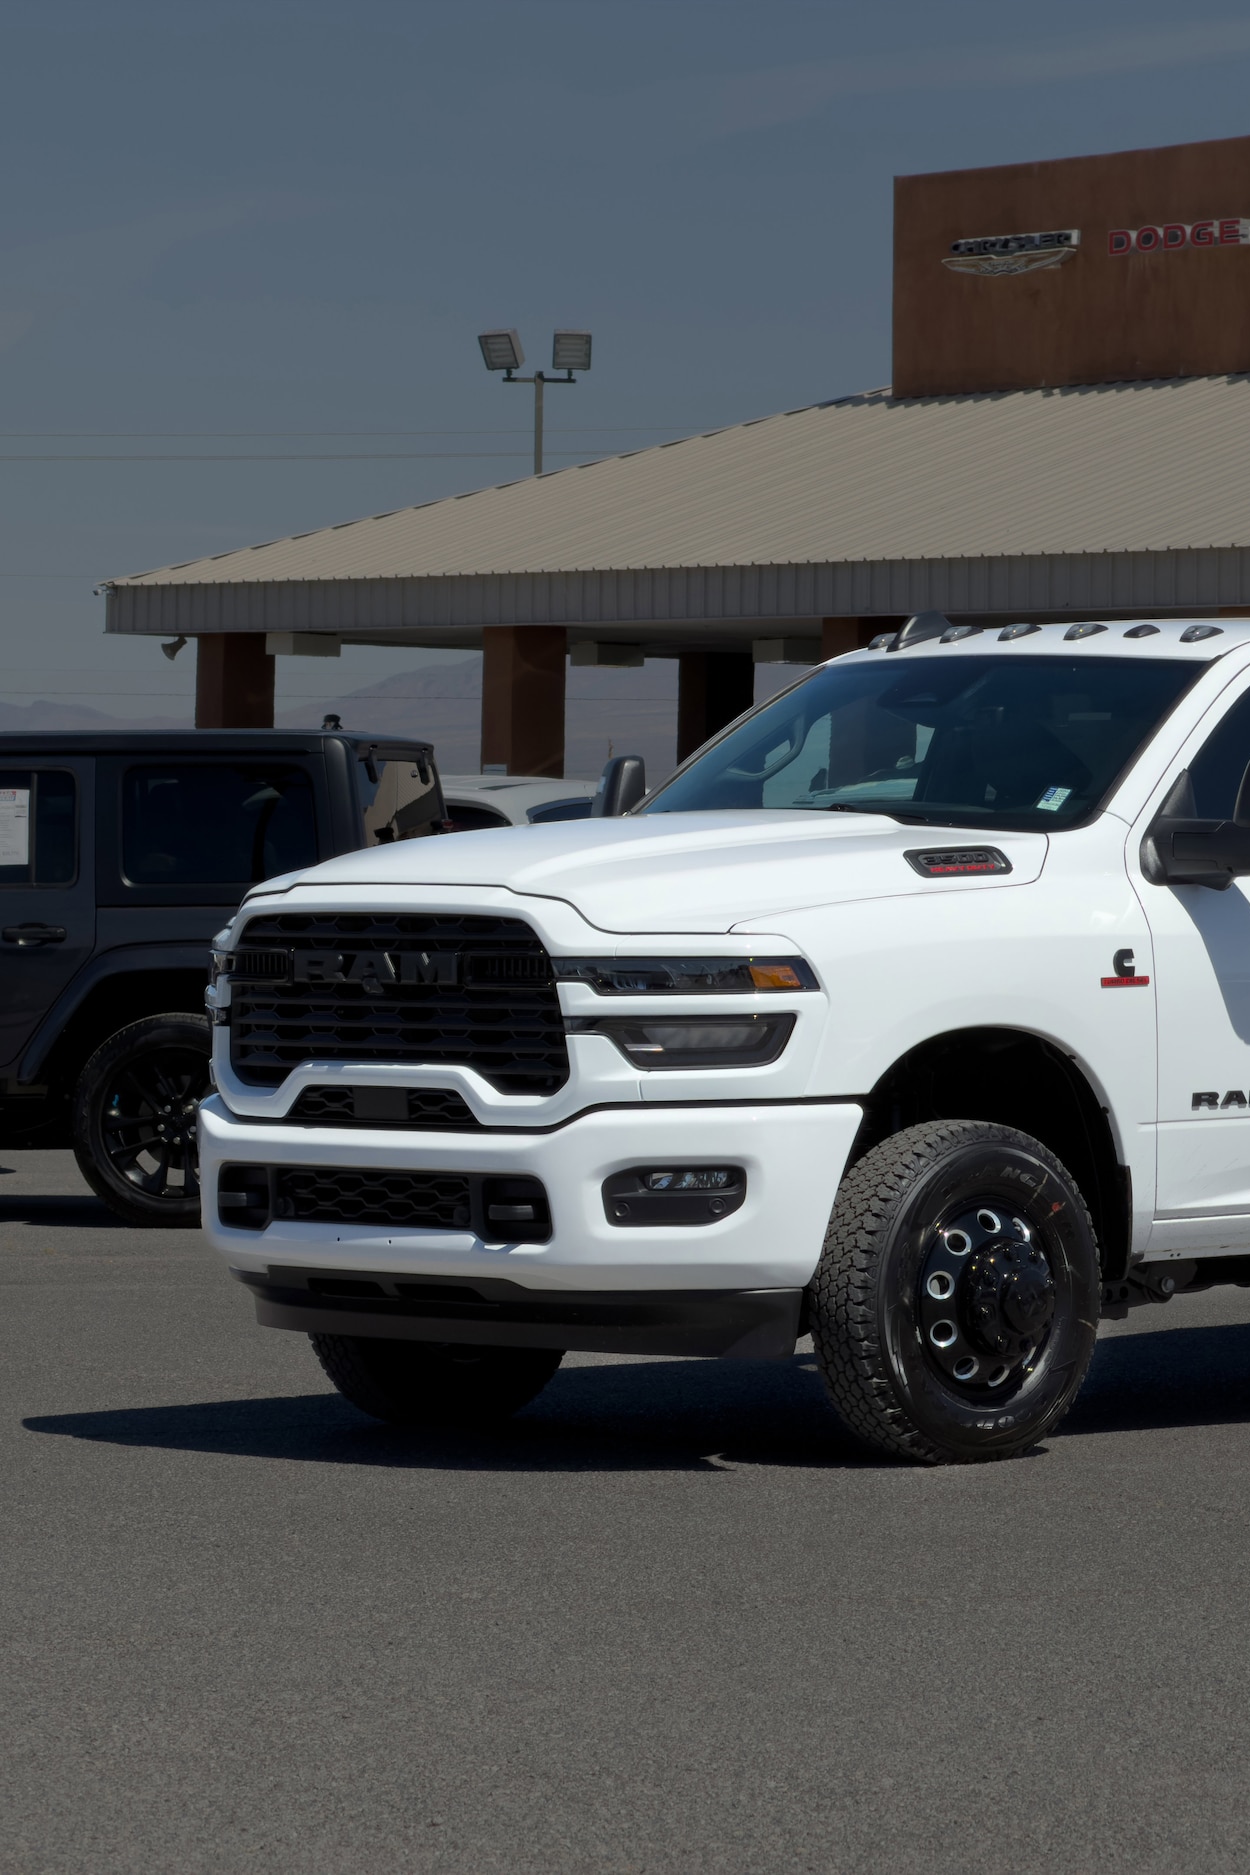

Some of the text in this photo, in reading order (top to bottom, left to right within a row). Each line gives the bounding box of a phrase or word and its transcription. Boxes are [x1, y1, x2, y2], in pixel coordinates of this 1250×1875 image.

[1108, 219, 1244, 256] DODGE
[923, 853, 989, 866] 3500
[294, 950, 459, 985] RAM
